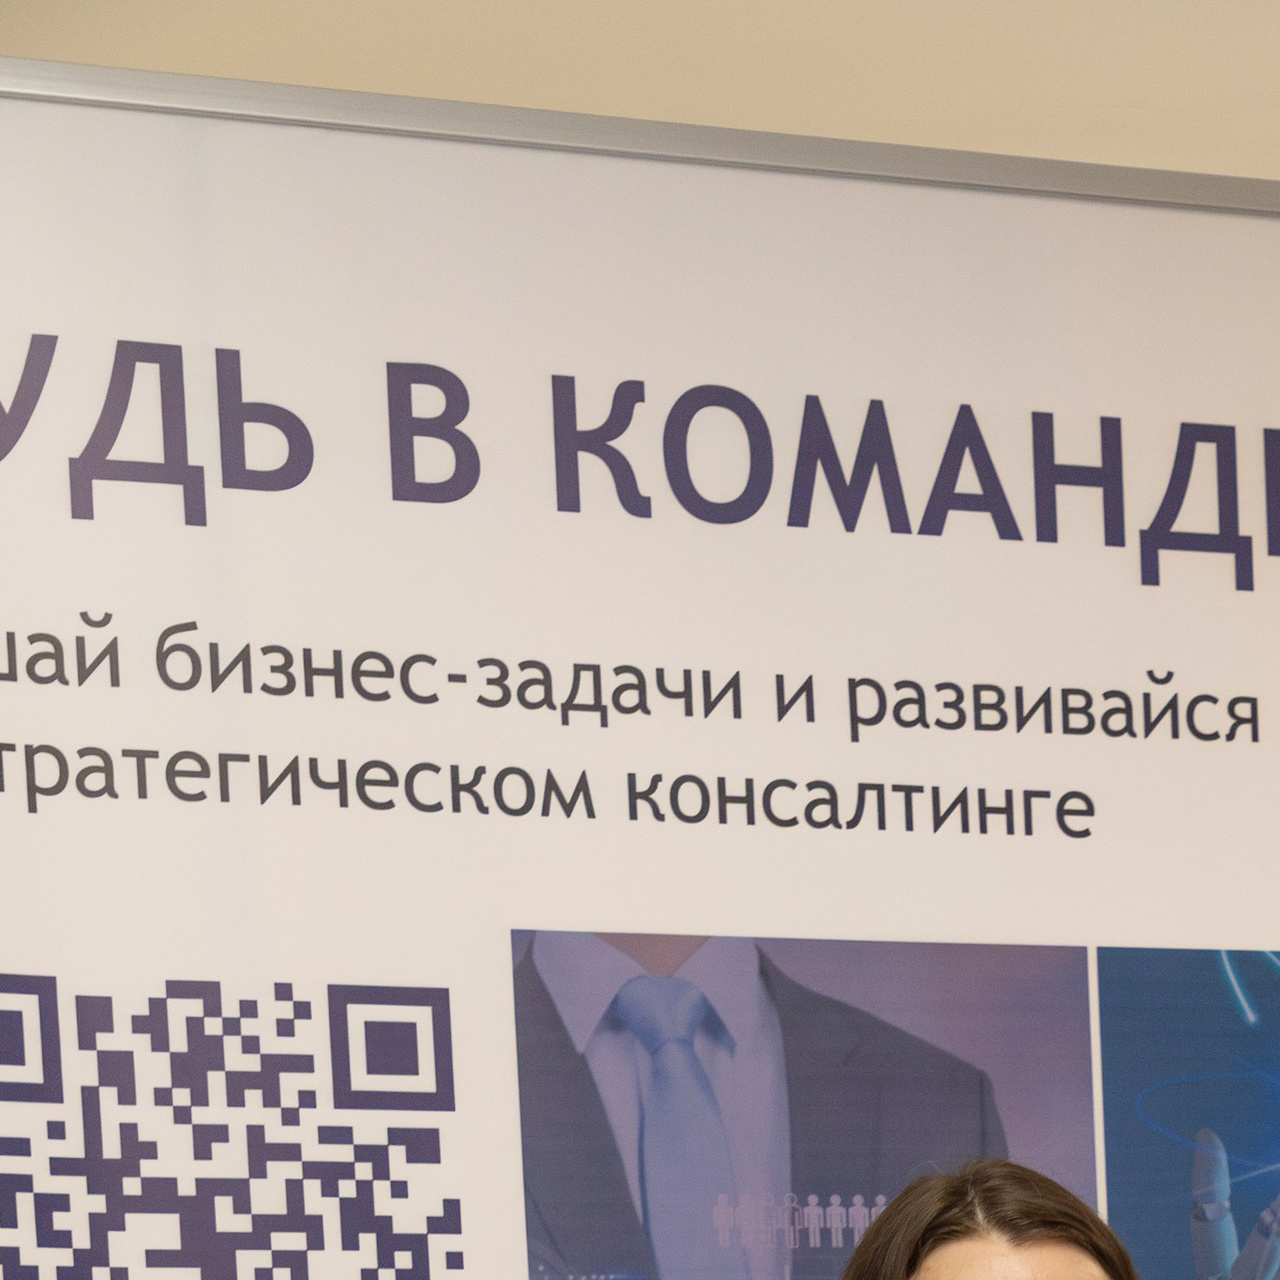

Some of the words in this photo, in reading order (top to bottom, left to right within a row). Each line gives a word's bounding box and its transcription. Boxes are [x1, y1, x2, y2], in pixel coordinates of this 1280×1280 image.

[386, 361, 481, 504] В
[155, 620, 742, 729] бизнес-задачи
[775, 673, 816, 723] и
[847, 669, 1260, 743] развивайся
[626, 772, 1096, 839] консалтинге
